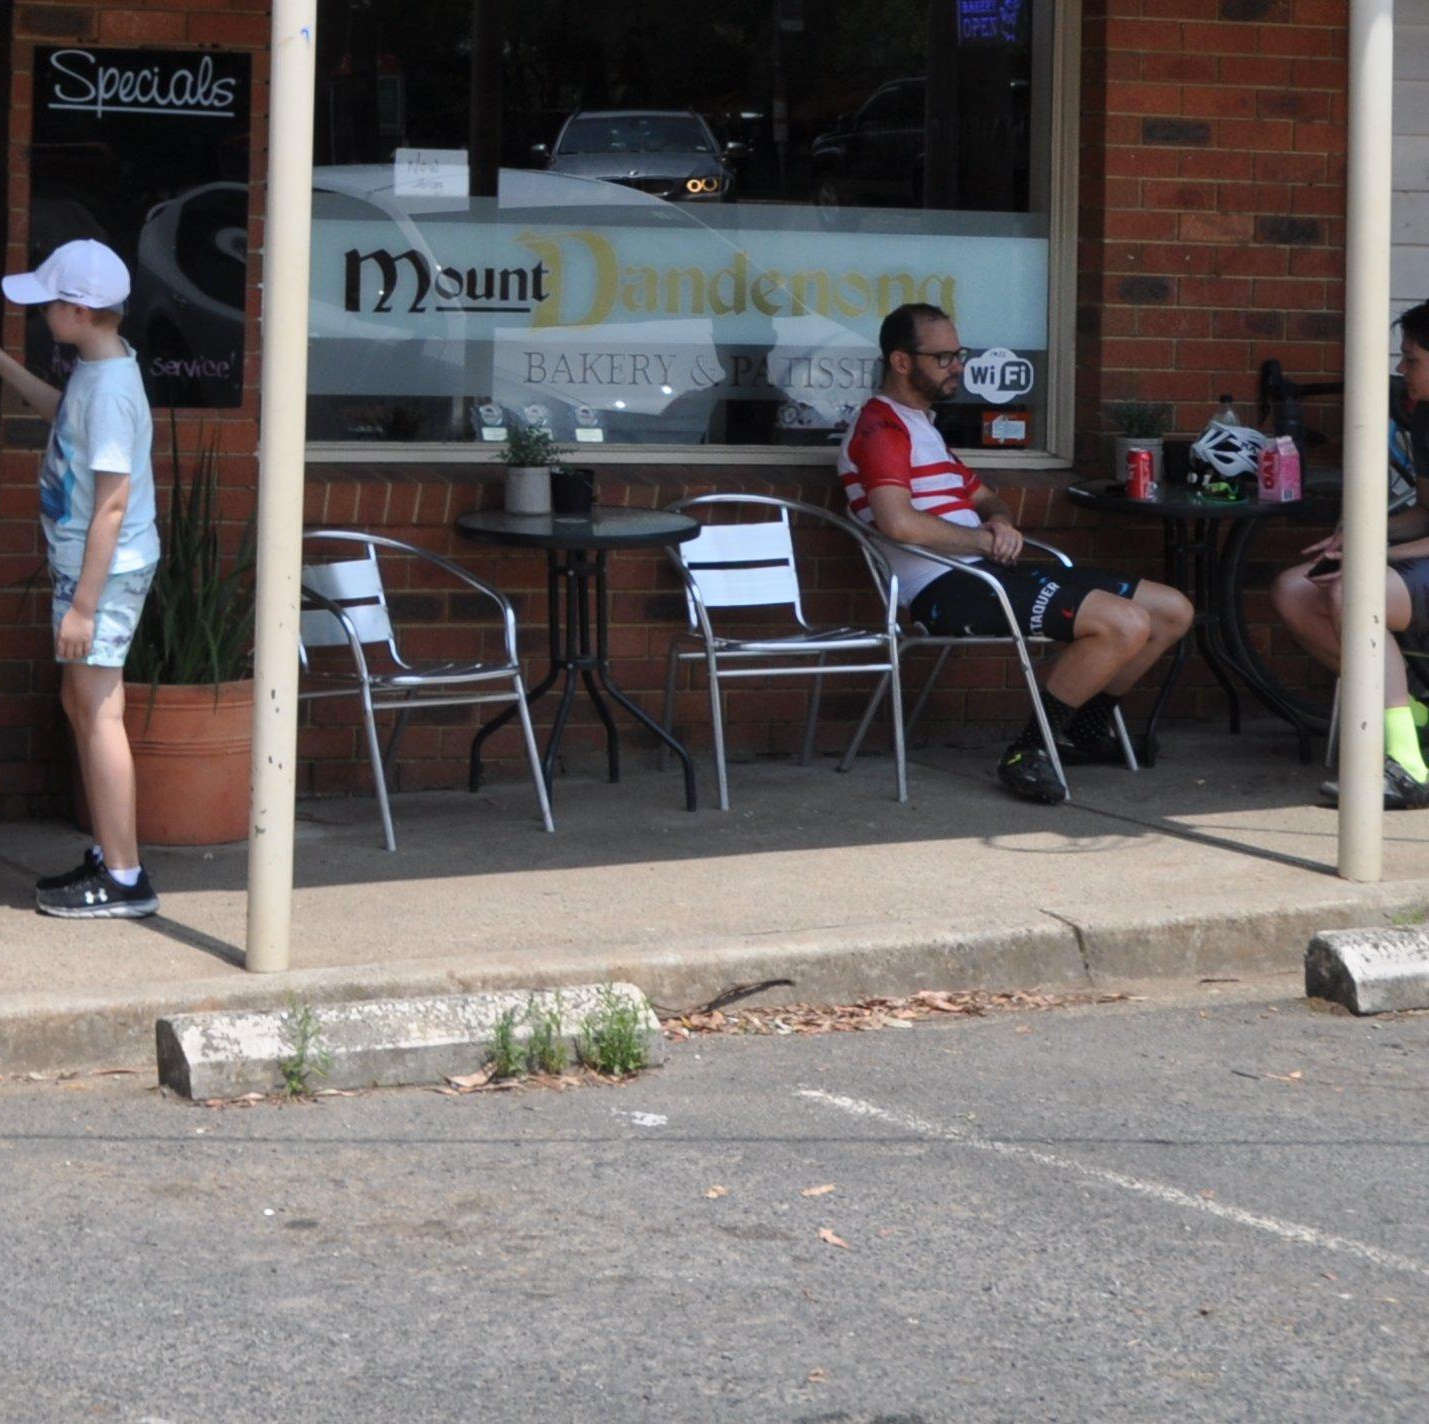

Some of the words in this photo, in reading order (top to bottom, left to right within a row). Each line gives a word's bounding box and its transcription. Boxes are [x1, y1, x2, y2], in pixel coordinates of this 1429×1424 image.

[963, 16, 998, 38] OPEN
[50, 48, 237, 118] Specials
[344, 247, 550, 313] Mount
[523, 351, 677, 386] BAKERY
[691, 354, 721, 388] &
